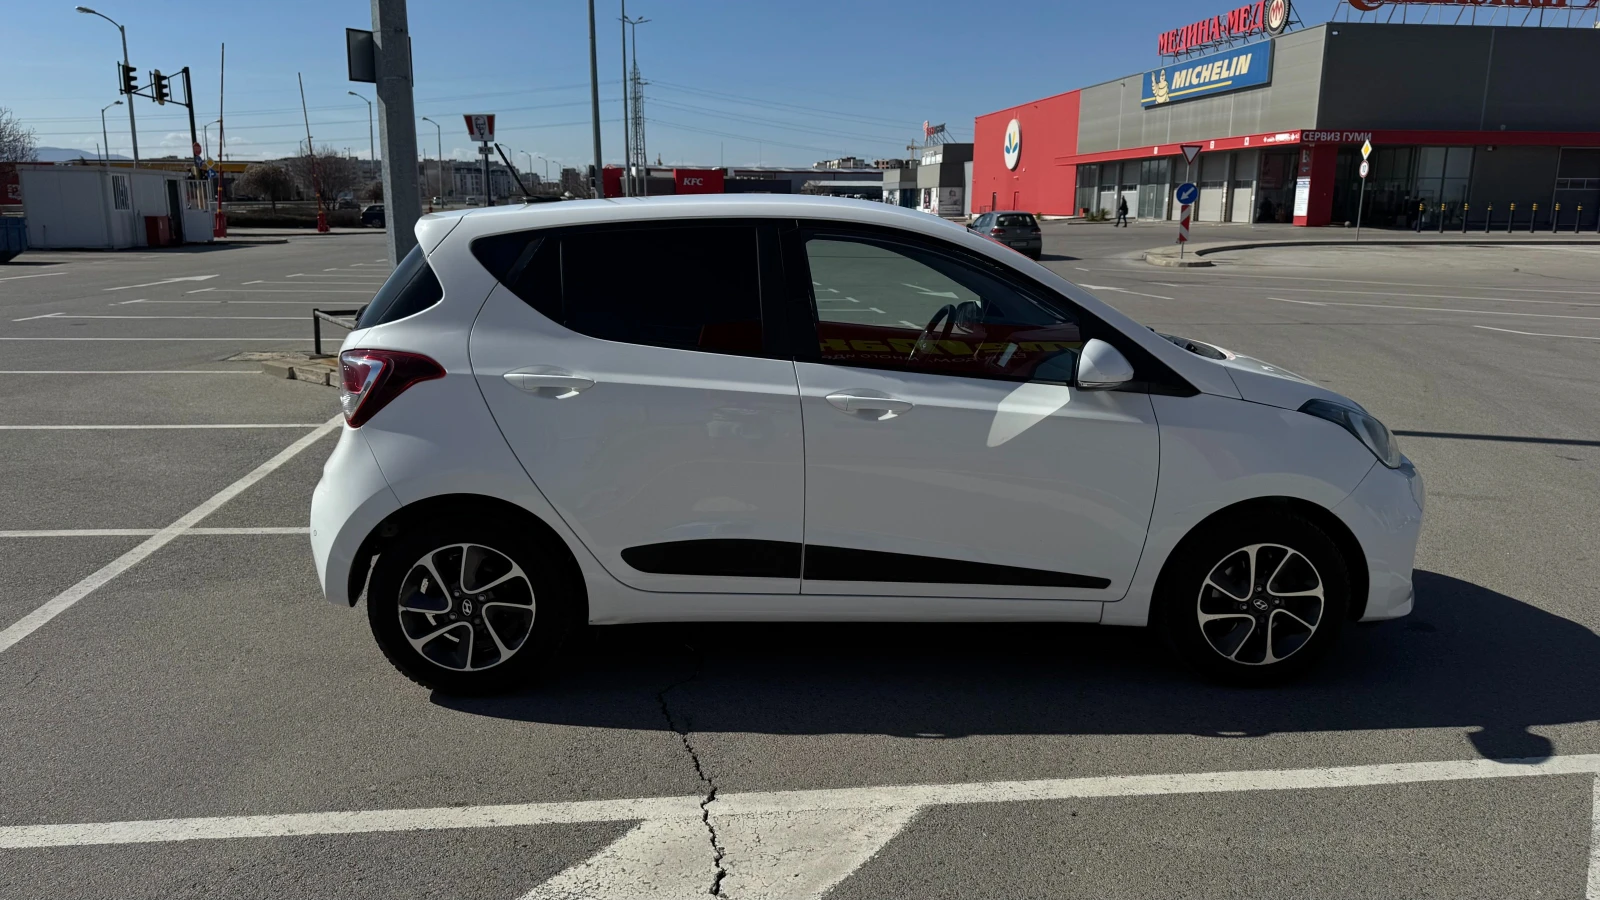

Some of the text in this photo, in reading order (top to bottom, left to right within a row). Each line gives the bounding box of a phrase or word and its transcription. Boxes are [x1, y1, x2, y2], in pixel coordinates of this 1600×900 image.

[1157, 1, 1266, 56] МЕДИНА-МЕД
[1172, 53, 1252, 90] MICHELIN
[1302, 131, 1340, 141] СЕРВИЗ
[1343, 131, 1372, 141] ГУМИ
[683, 177, 704, 186] KFC
